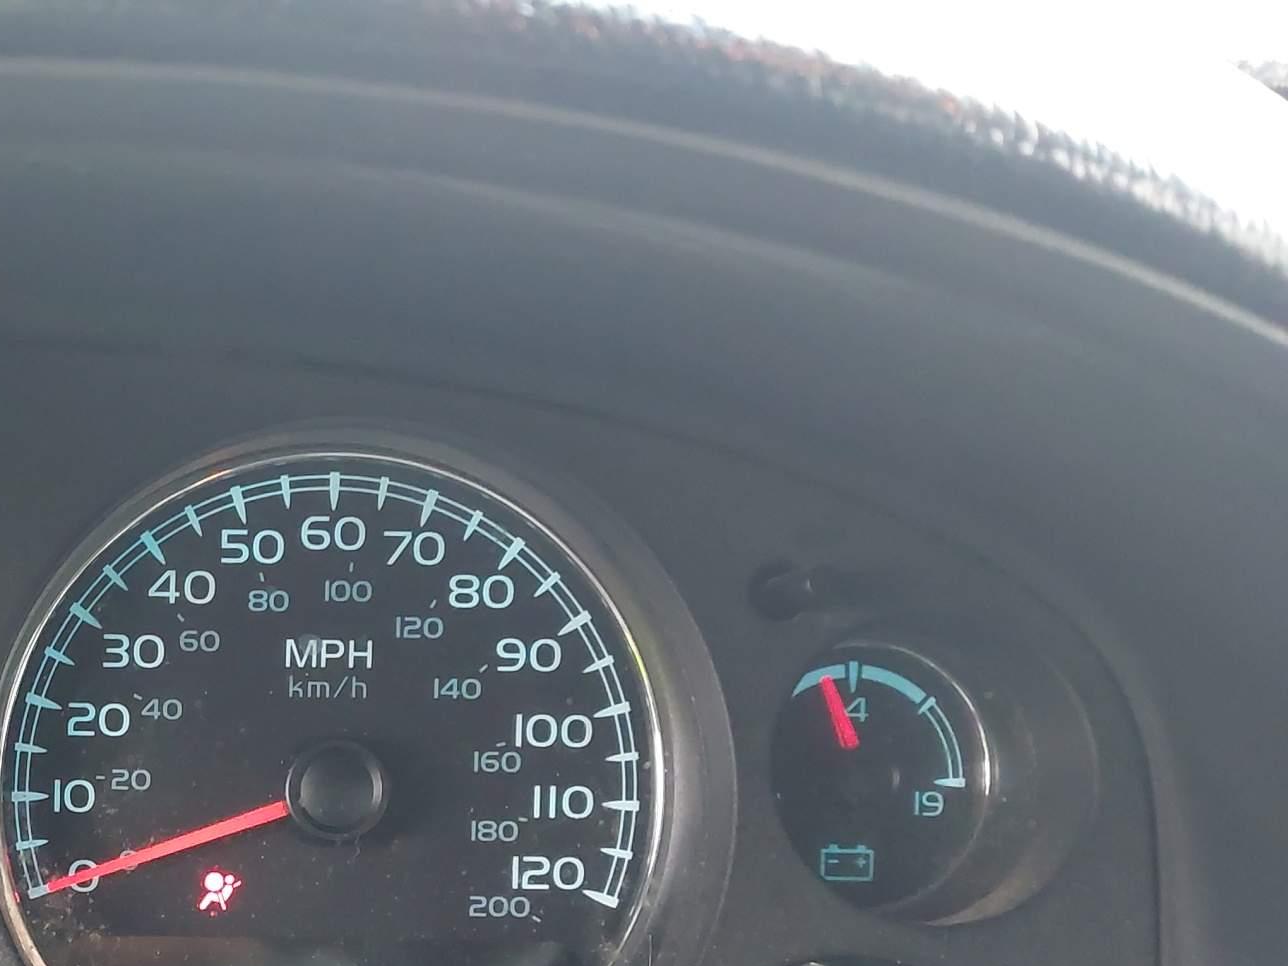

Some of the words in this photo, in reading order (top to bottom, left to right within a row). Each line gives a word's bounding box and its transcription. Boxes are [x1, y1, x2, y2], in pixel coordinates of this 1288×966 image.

[220, 529, 285, 565] 50
[300, 516, 366, 552] 60
[383, 530, 446, 566] 70
[148, 569, 216, 605] 40
[248, 591, 290, 612] 80
[323, 580, 373, 602] 100
[447, 573, 515, 609] 80
[179, 630, 220, 652] 60
[395, 616, 444, 640] 120
[102, 634, 165, 668] 30
[284, 640, 374, 669] MPH
[495, 638, 562, 674] 90
[288, 676, 368, 701] km/h
[433, 677, 482, 700] 140
[67, 703, 130, 737] 20
[141, 698, 183, 721] 40
[514, 714, 593, 748] 100
[472, 752, 522, 773] 160
[111, 769, 152, 791] 20
[53, 779, 96, 813] 10
[533, 785, 595, 818] 110
[914, 791, 944, 816] 19
[470, 820, 519, 842] 180
[68, 859, 99, 893] 0
[511, 856, 585, 890] 120
[468, 896, 531, 918] 200
